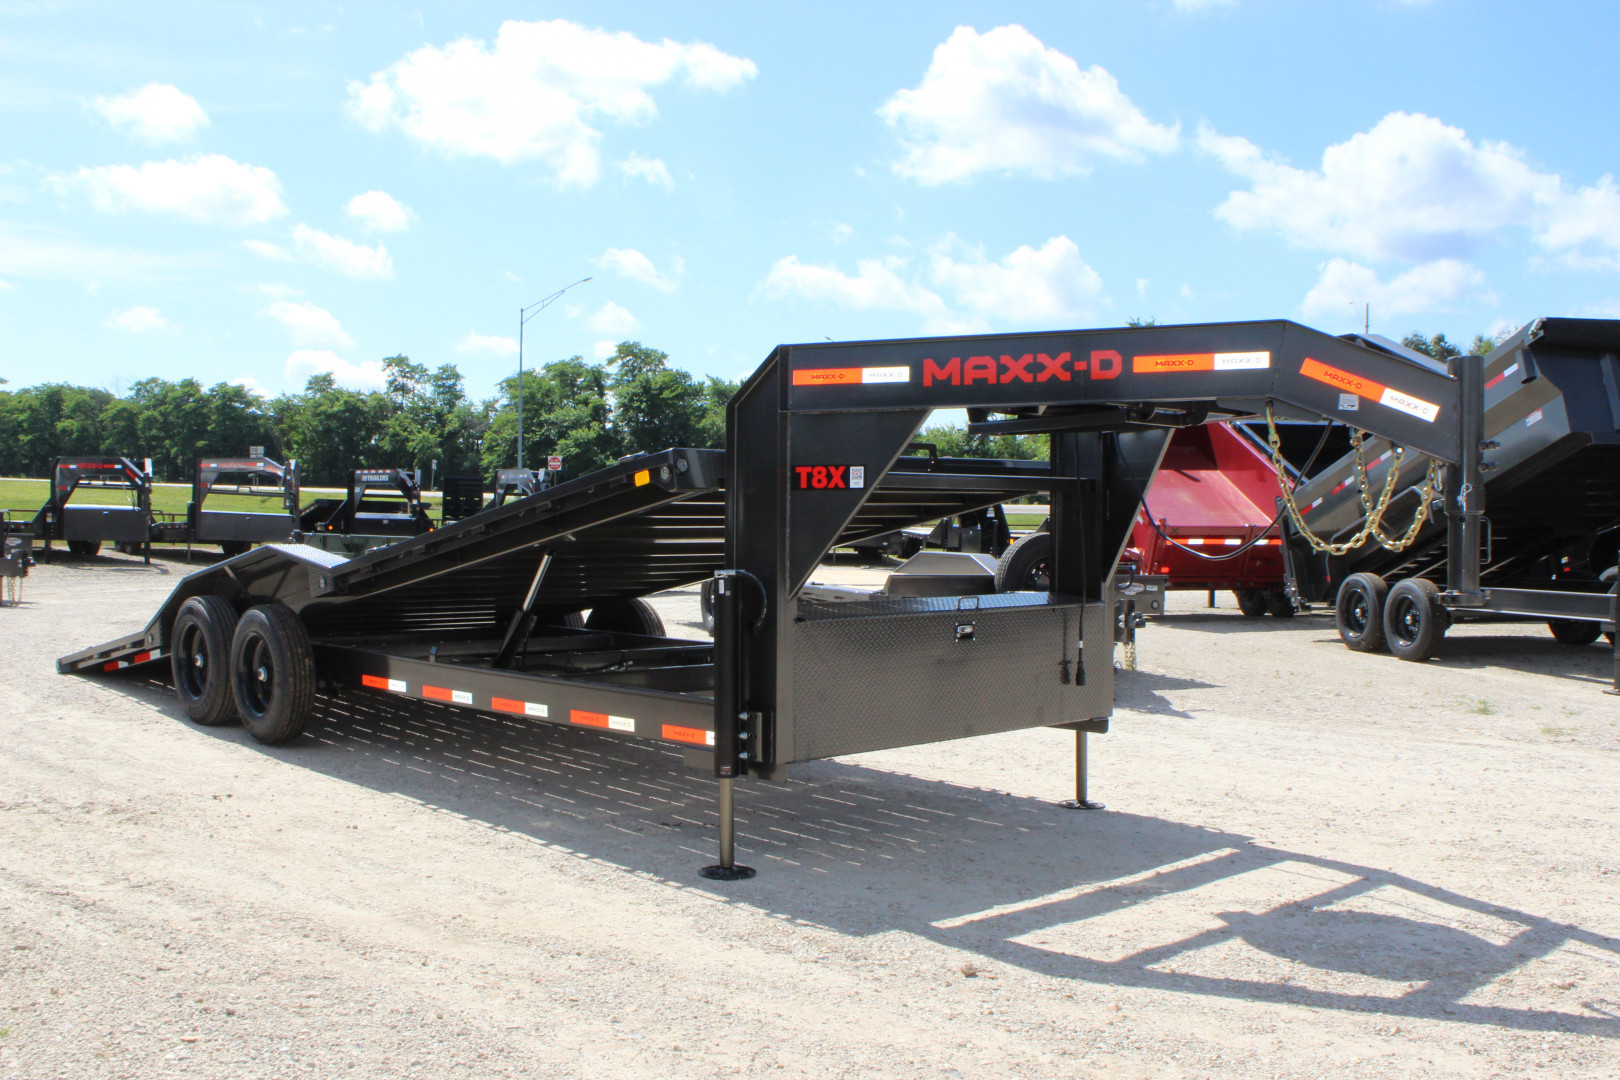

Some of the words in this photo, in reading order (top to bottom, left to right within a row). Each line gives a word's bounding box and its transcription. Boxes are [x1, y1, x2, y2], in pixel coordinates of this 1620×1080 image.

[923, 350, 1123, 387] MAXX-D
[1155, 359, 1195, 367] MAXX-D
[1323, 371, 1363, 390] MAXX-D
[1390, 395, 1430, 415] MAXX-D
[795, 466, 846, 488] T8X
